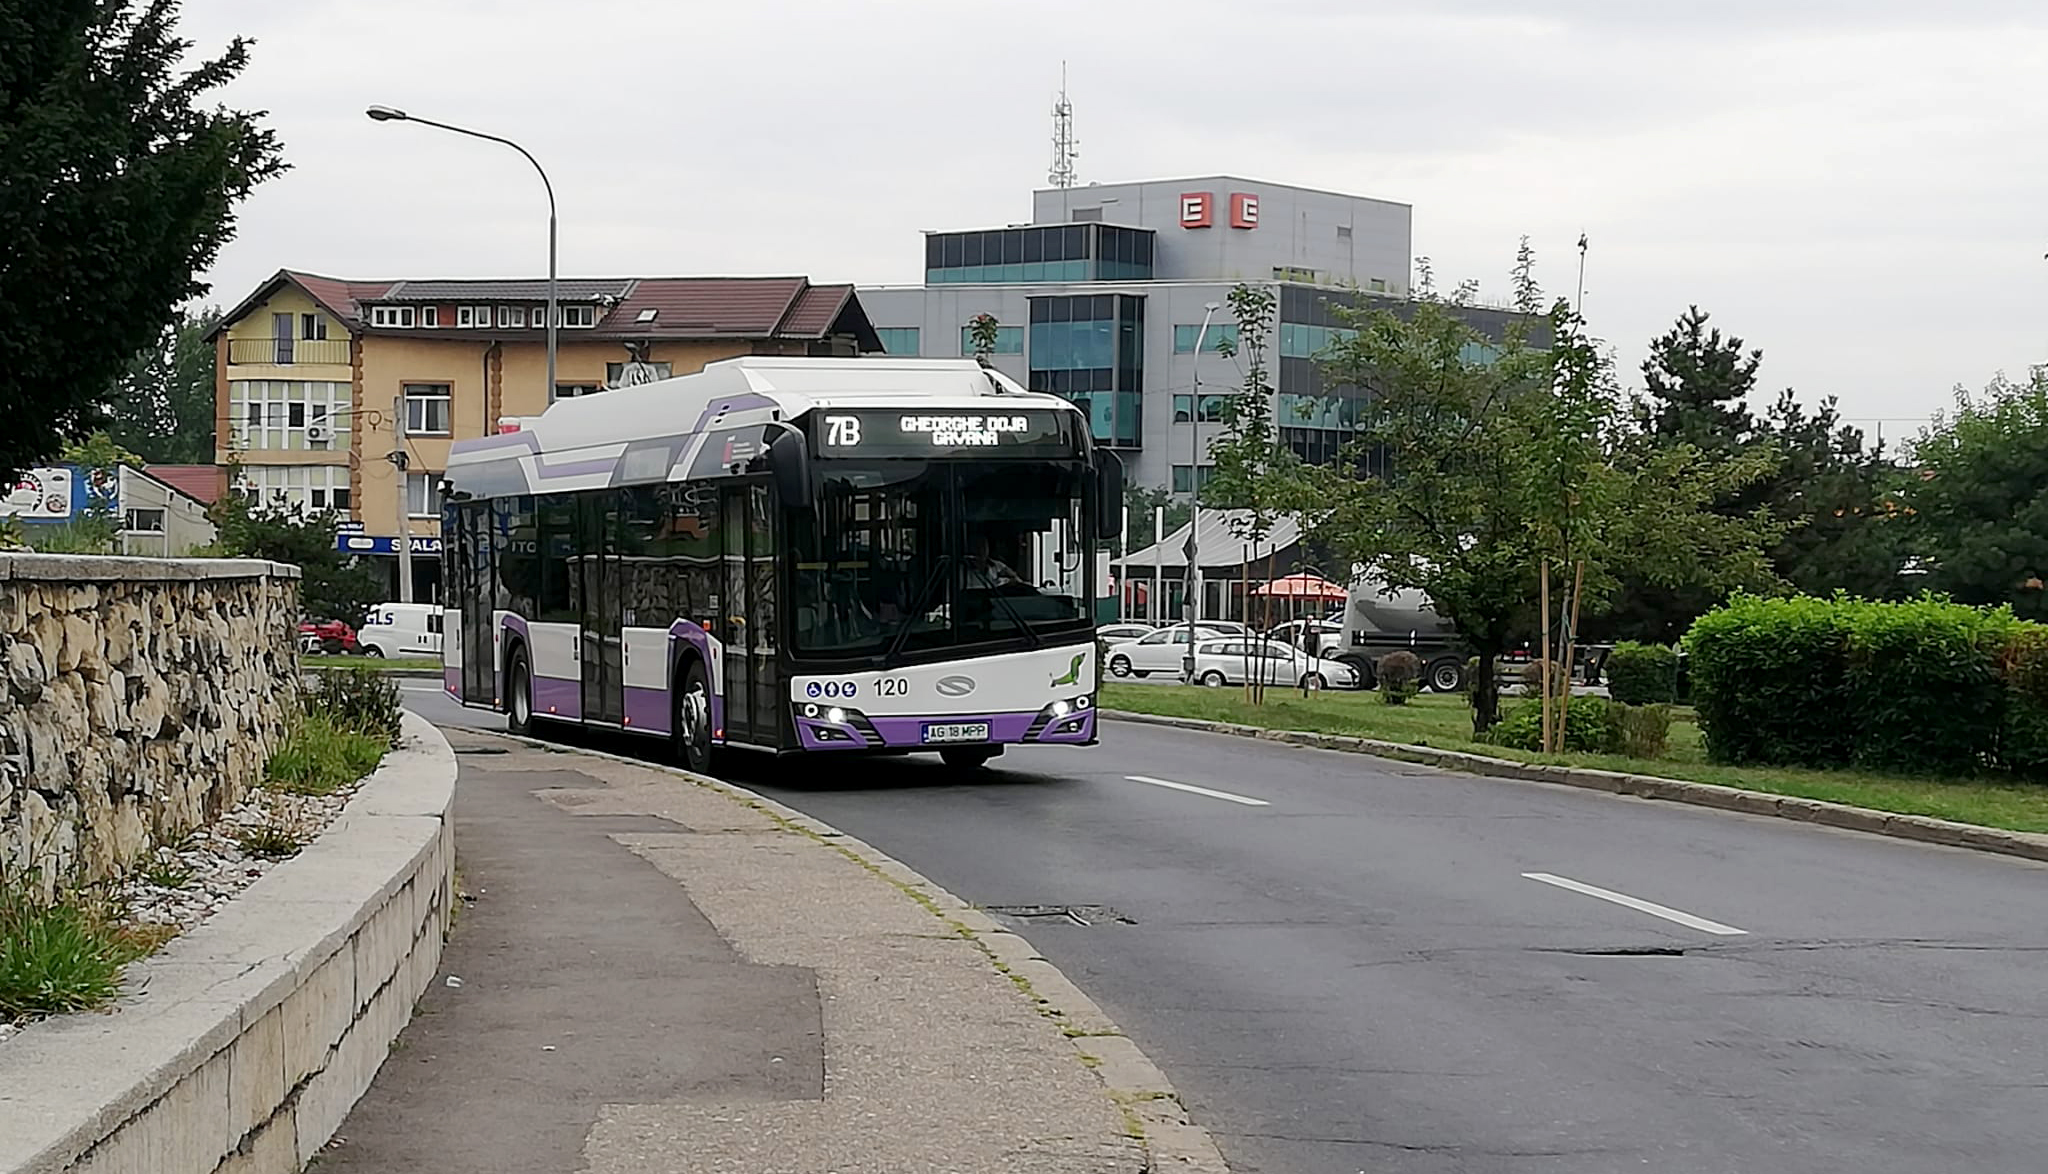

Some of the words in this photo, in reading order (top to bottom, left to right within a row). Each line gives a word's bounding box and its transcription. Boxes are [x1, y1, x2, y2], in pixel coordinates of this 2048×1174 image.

[825, 416, 861, 446] 7B
[901, 416, 984, 432] GHEORGHE
[987, 416, 1028, 432] DOJA
[932, 431, 999, 446] GAVANA
[873, 678, 909, 697] 120
[930, 726, 945, 738] AG
[949, 726, 960, 737] 18
